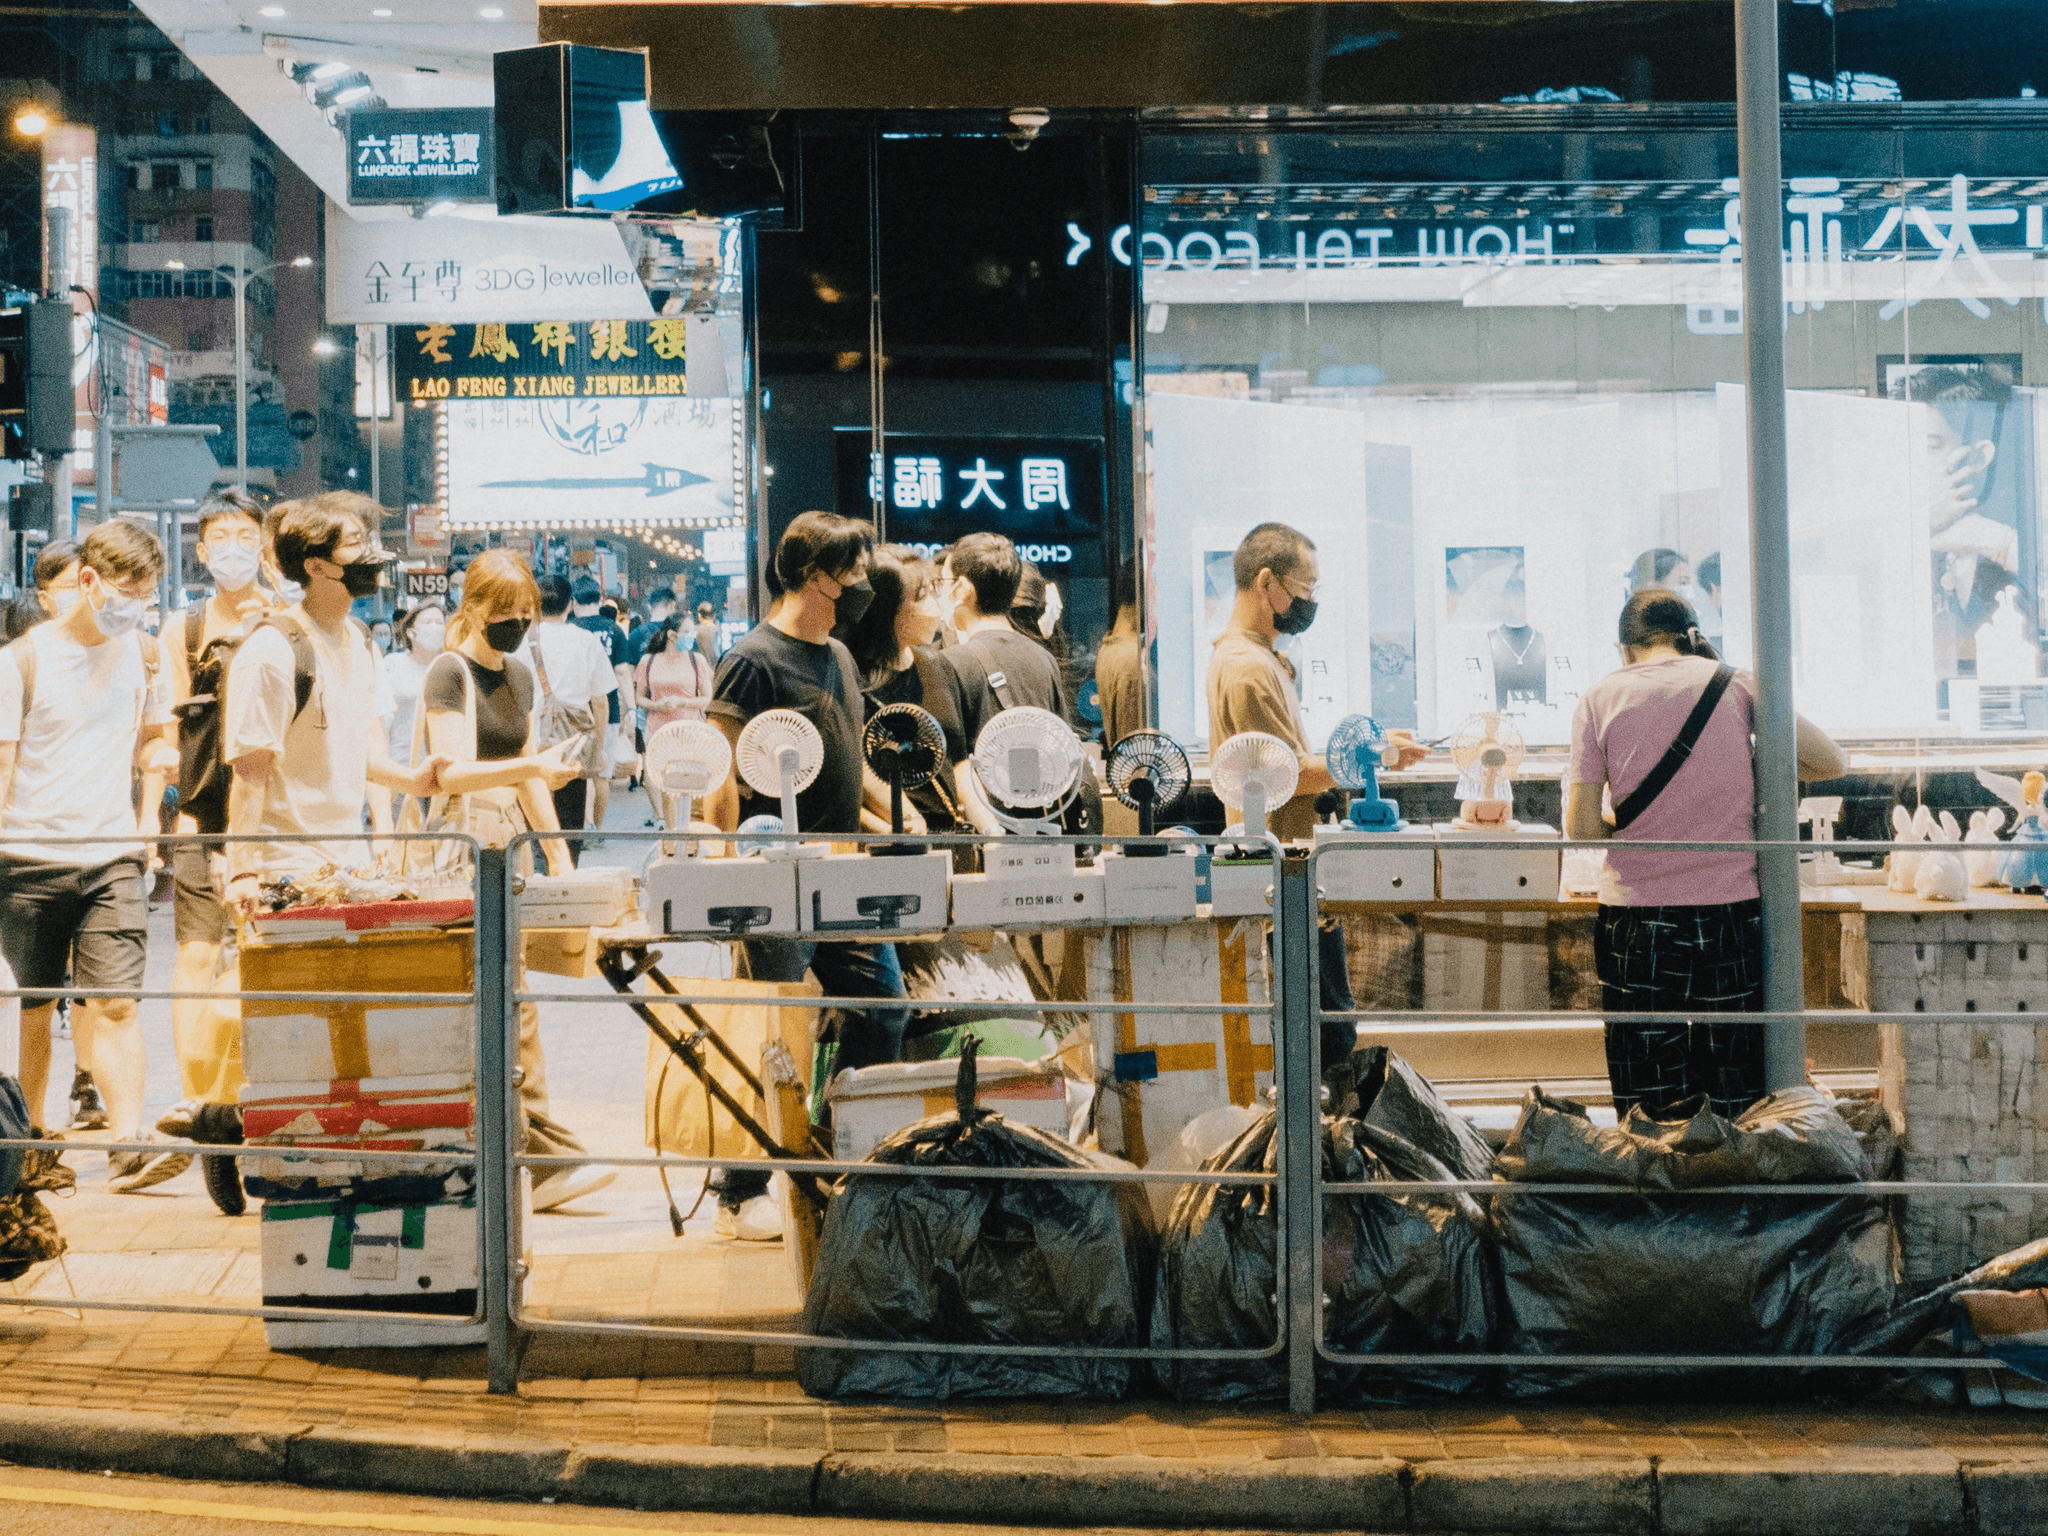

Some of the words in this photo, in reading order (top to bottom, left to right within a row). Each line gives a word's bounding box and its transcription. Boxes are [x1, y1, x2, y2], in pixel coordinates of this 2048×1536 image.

[358, 132, 480, 164] 六福珠寶
[358, 164, 412, 176] LUKFOOK
[413, 163, 480, 176] JEWELLERY
[364, 260, 463, 303] 金至尊
[475, 268, 536, 291] 3DG
[411, 377, 451, 398] LAO
[457, 376, 508, 398] FENG
[513, 376, 577, 397] XIANG
[583, 374, 688, 396] JEWELLERY
[408, 574, 449, 594] N59
